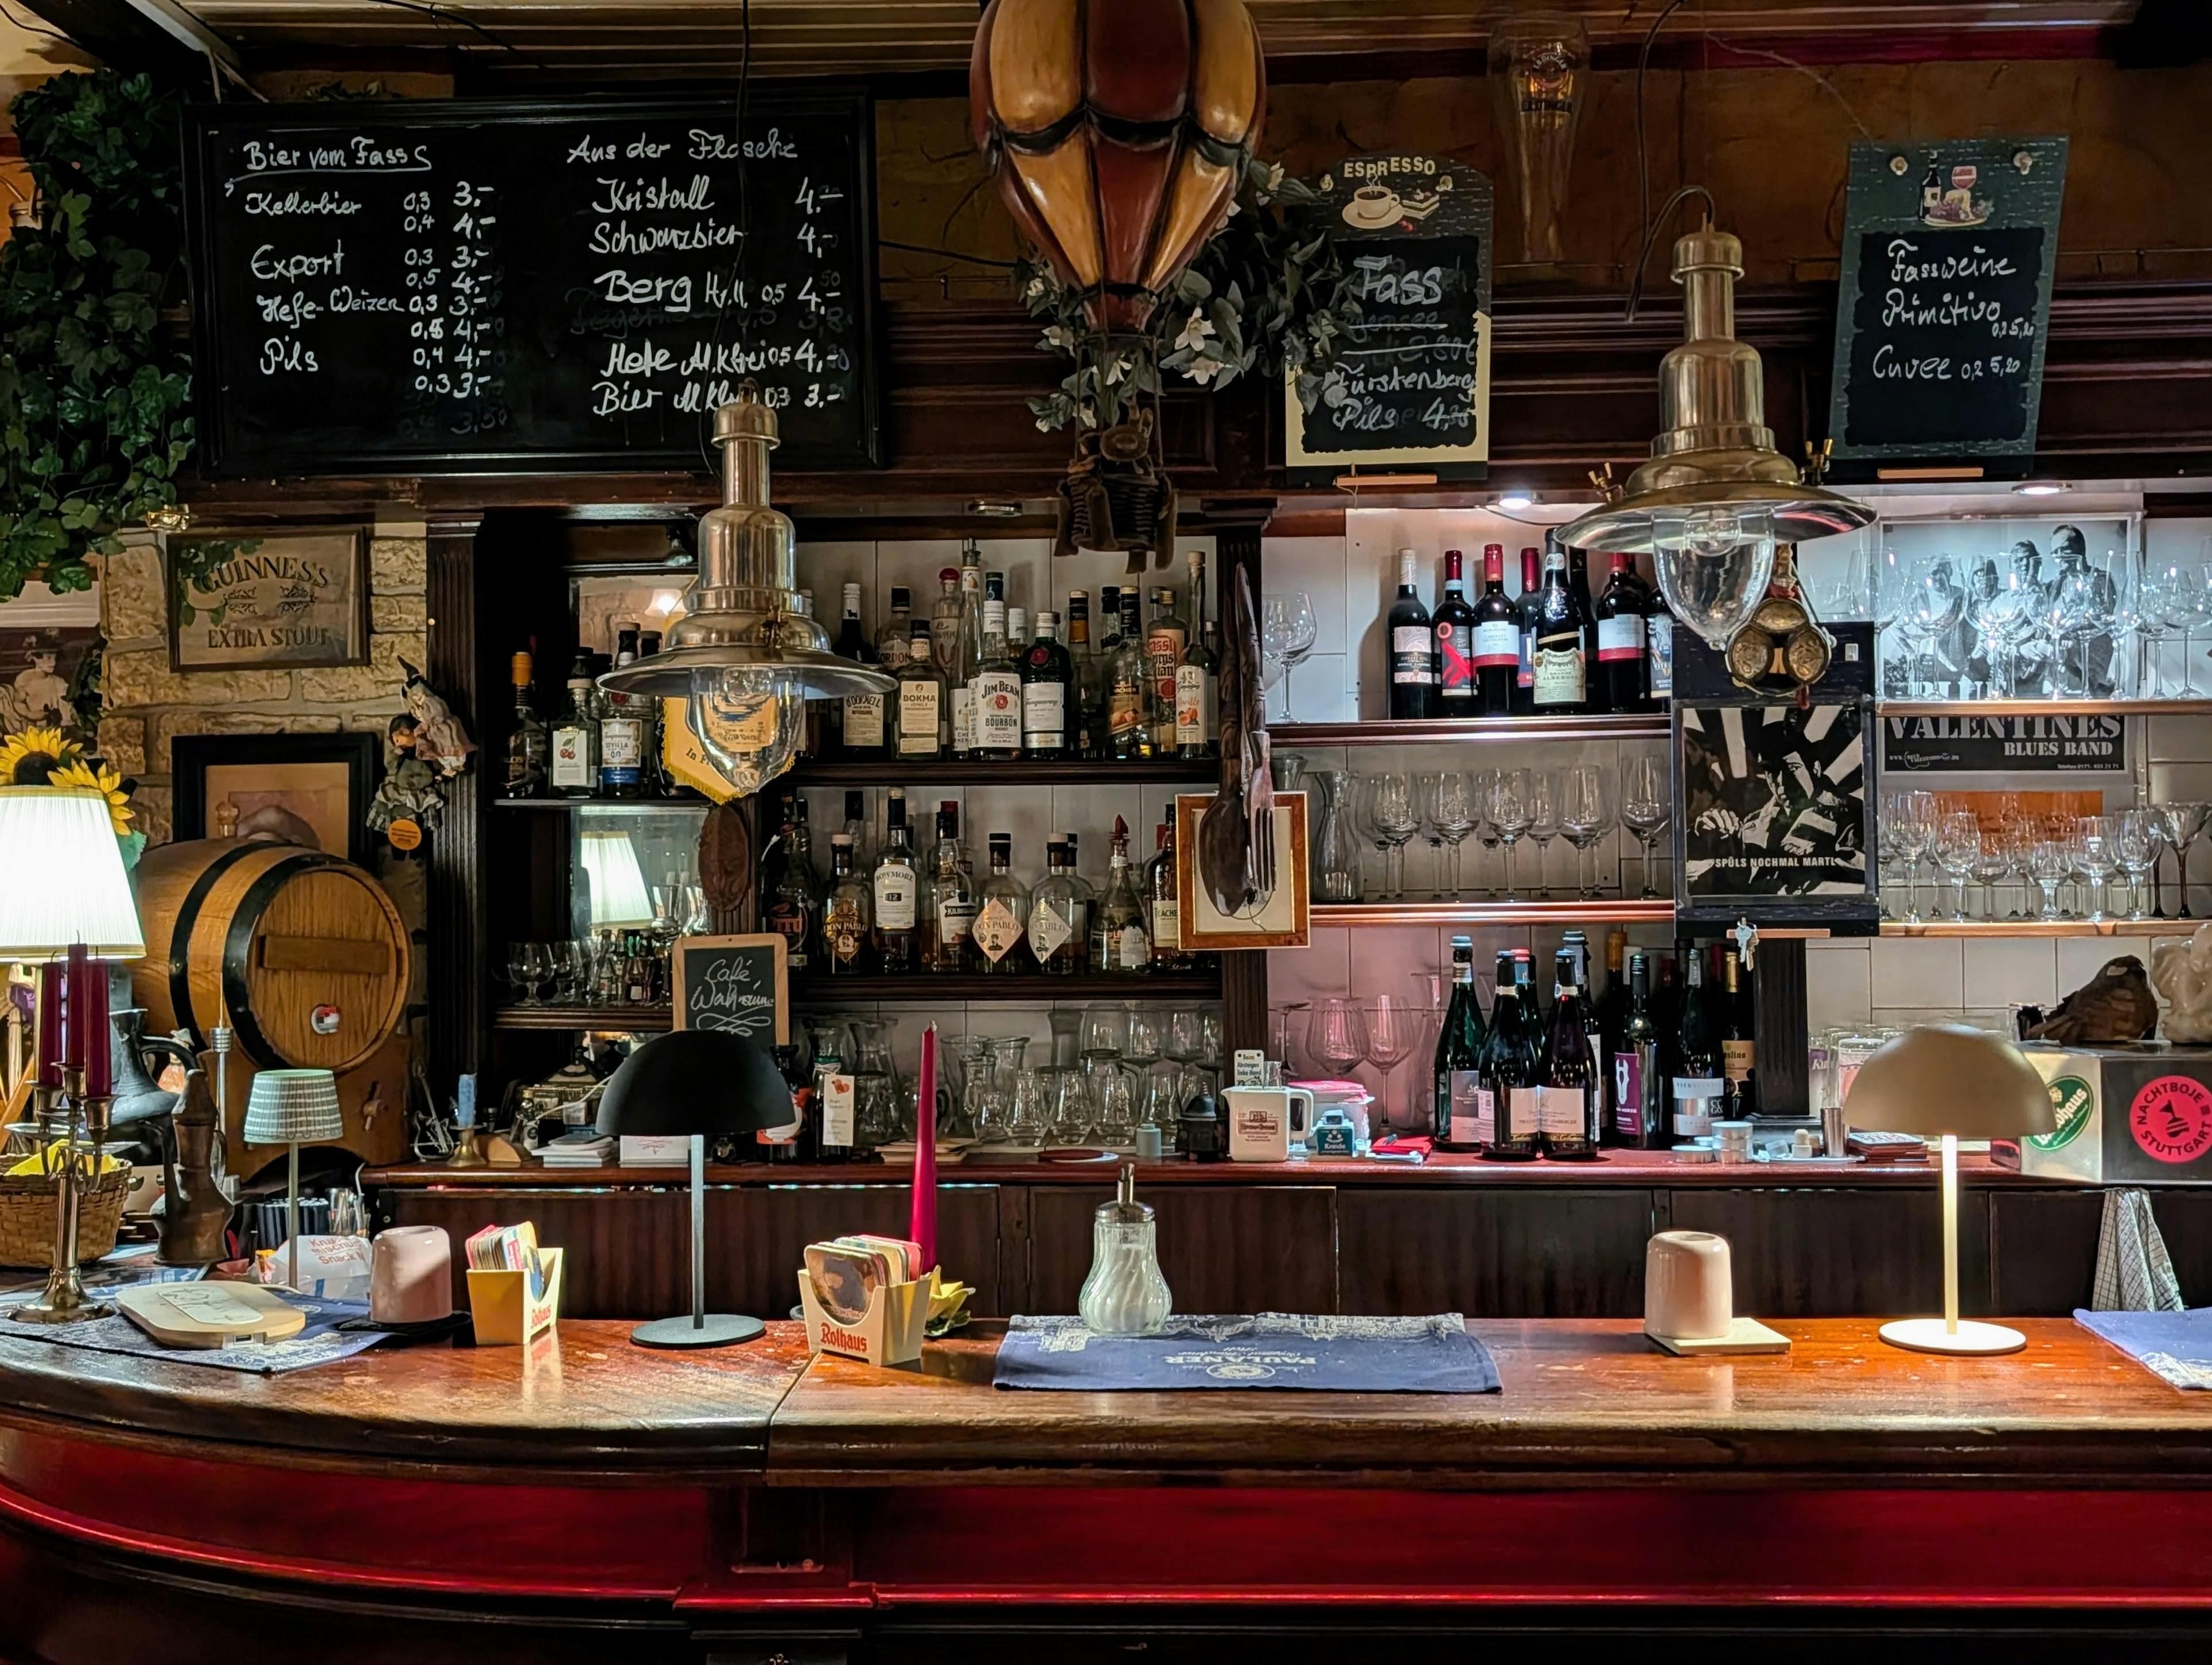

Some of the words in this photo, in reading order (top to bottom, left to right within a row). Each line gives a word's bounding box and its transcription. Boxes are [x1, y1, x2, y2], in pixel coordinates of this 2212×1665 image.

[243, 142, 299, 170] Bier
[310, 147, 346, 169] vom
[567, 134, 616, 163] Aus
[626, 132, 671, 158] der
[688, 128, 798, 159] Flasche
[1343, 156, 1436, 178] ESPRESSO
[246, 190, 361, 216] Kellerbier
[404, 192, 431, 213] 0,3
[592, 174, 715, 213] Kristall
[404, 216, 434, 233] 0,4
[589, 219, 744, 255] Schwarzbier
[251, 239, 344, 283] Export
[405, 249, 433, 267] 0,3
[1887, 239, 2017, 283] Fassweine
[594, 270, 691, 312] Berg
[1353, 254, 1442, 305] Fass
[1882, 288, 2001, 327] Primitivo
[260, 335, 318, 375] Pils
[1872, 344, 1953, 379] Cuvee
[591, 380, 663, 416] Bier
[208, 629, 267, 649] EXTRA
[270, 625, 329, 646] STOUT
[982, 683, 998, 699] JIM
[999, 680, 1020, 699] BEAM
[985, 718, 1017, 727] BOURBON
[1889, 716, 2121, 739] VALENTINES
[2004, 742, 2059, 757] BLUES
[2064, 741, 2113, 756] BAND
[1715, 856, 1747, 868] SPÜLS
[1750, 856, 1800, 868] NOCHMAL
[1802, 856, 1836, 867] MARTL
[875, 871, 914, 883] BOWMORE
[887, 892, 898, 901] 12
[823, 922, 843, 933] DON
[843, 922, 868, 933] PABLO
[992, 921, 1019, 931] PABLO
[704, 956, 751, 982] Café
[2137, 1082, 2204, 1126] NACHTBOJE
[2141, 1121, 2212, 1156] STUTTGART
[318, 1253, 356, 1265] Snack
[820, 1321, 868, 1354] Rothaus
[1163, 1355, 1317, 1364] PAULANER
